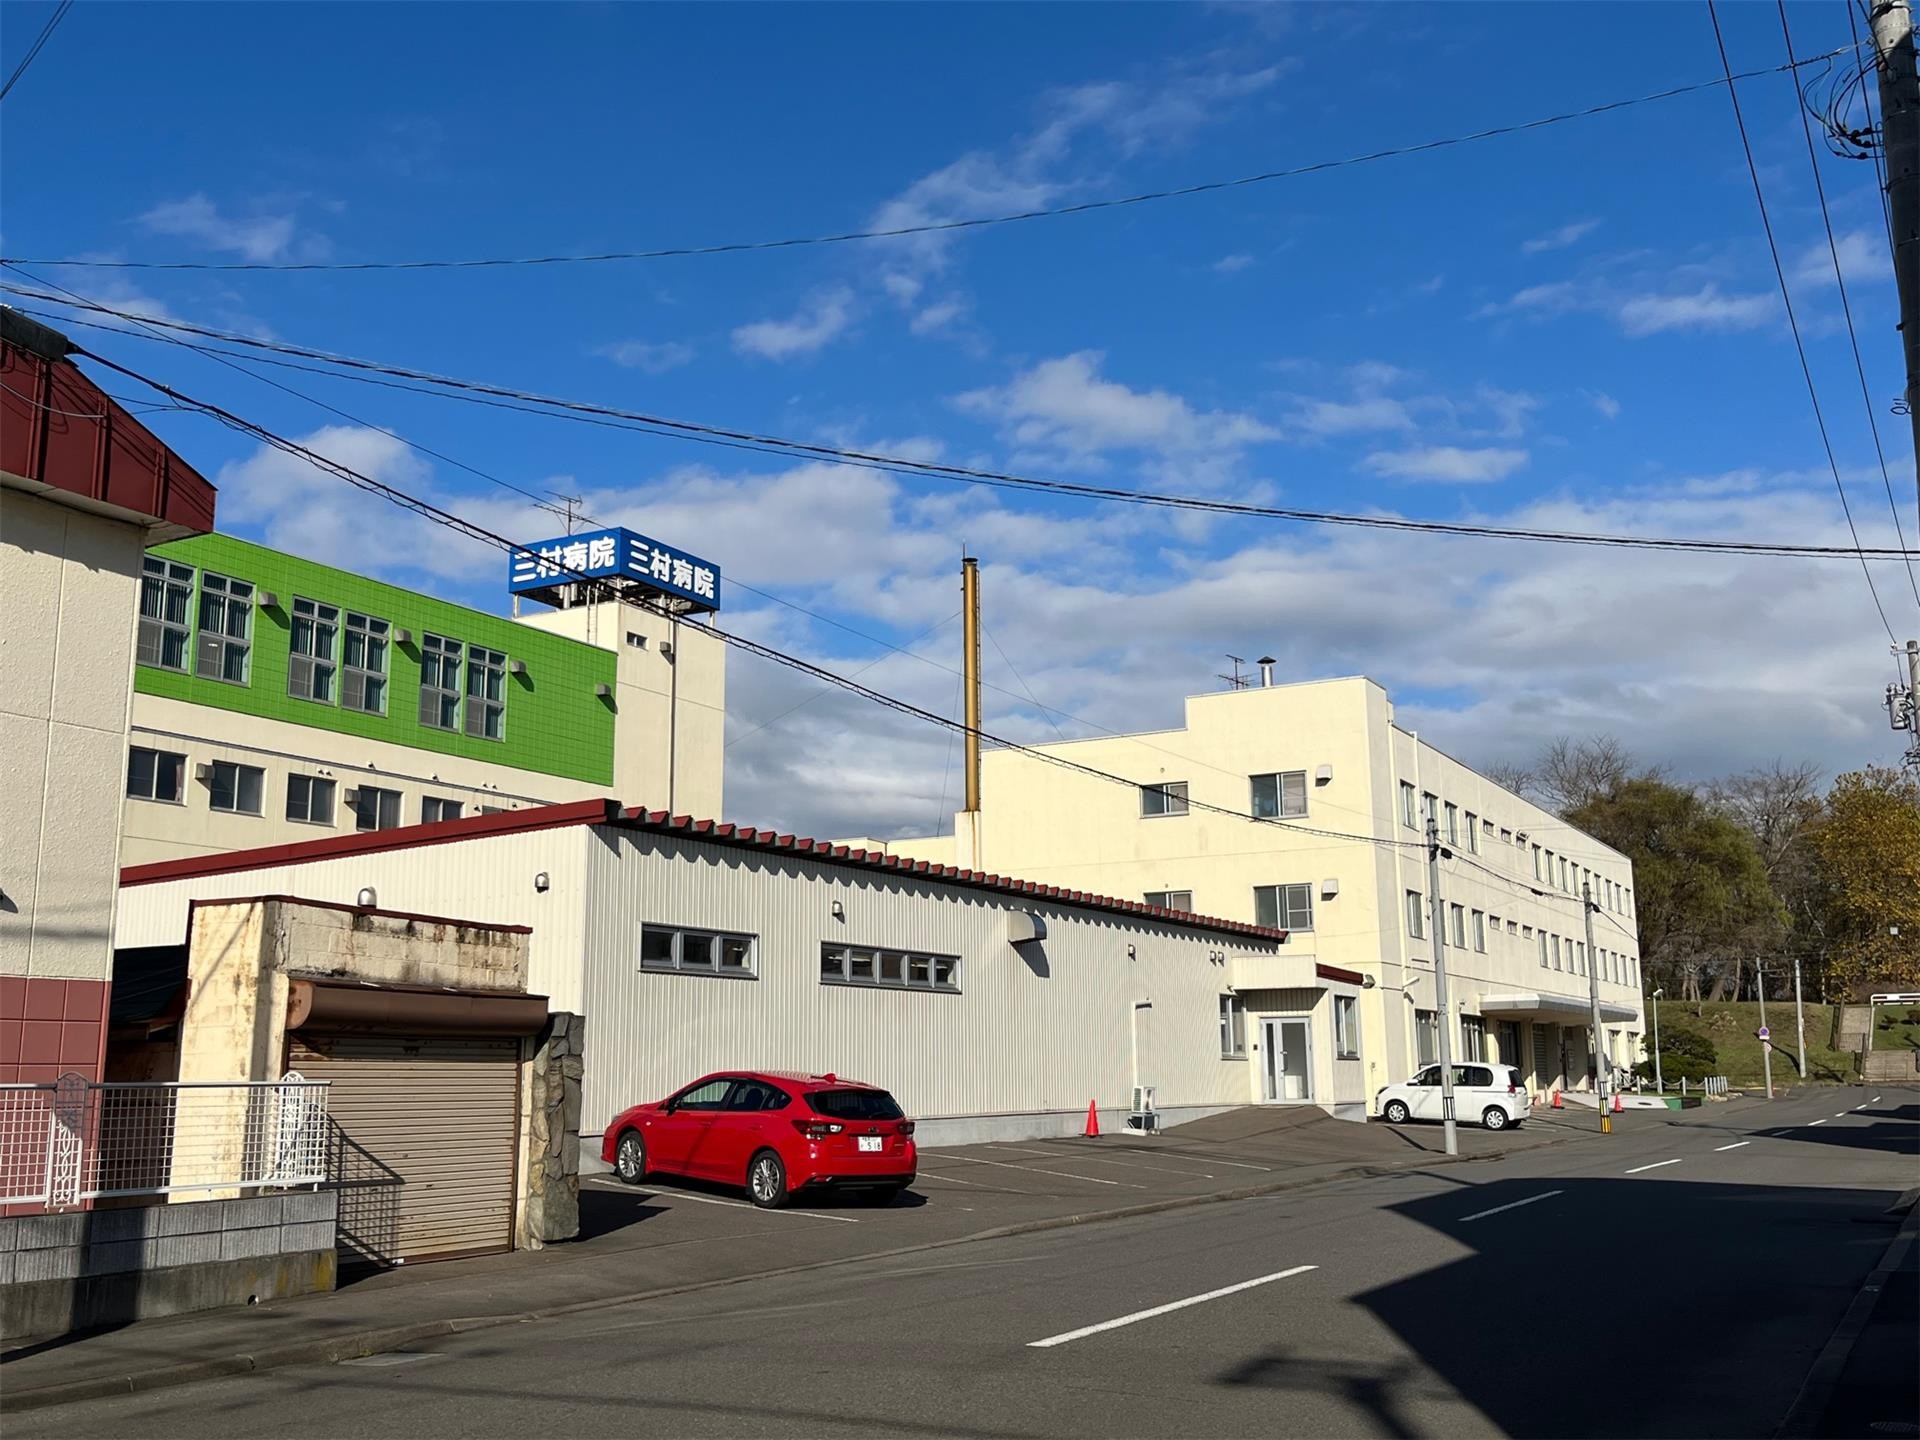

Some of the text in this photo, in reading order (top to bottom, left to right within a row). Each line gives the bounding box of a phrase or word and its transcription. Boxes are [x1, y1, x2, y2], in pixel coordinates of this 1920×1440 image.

[512, 536, 615, 583] 三村病院
[628, 539, 714, 599] 三村病院
